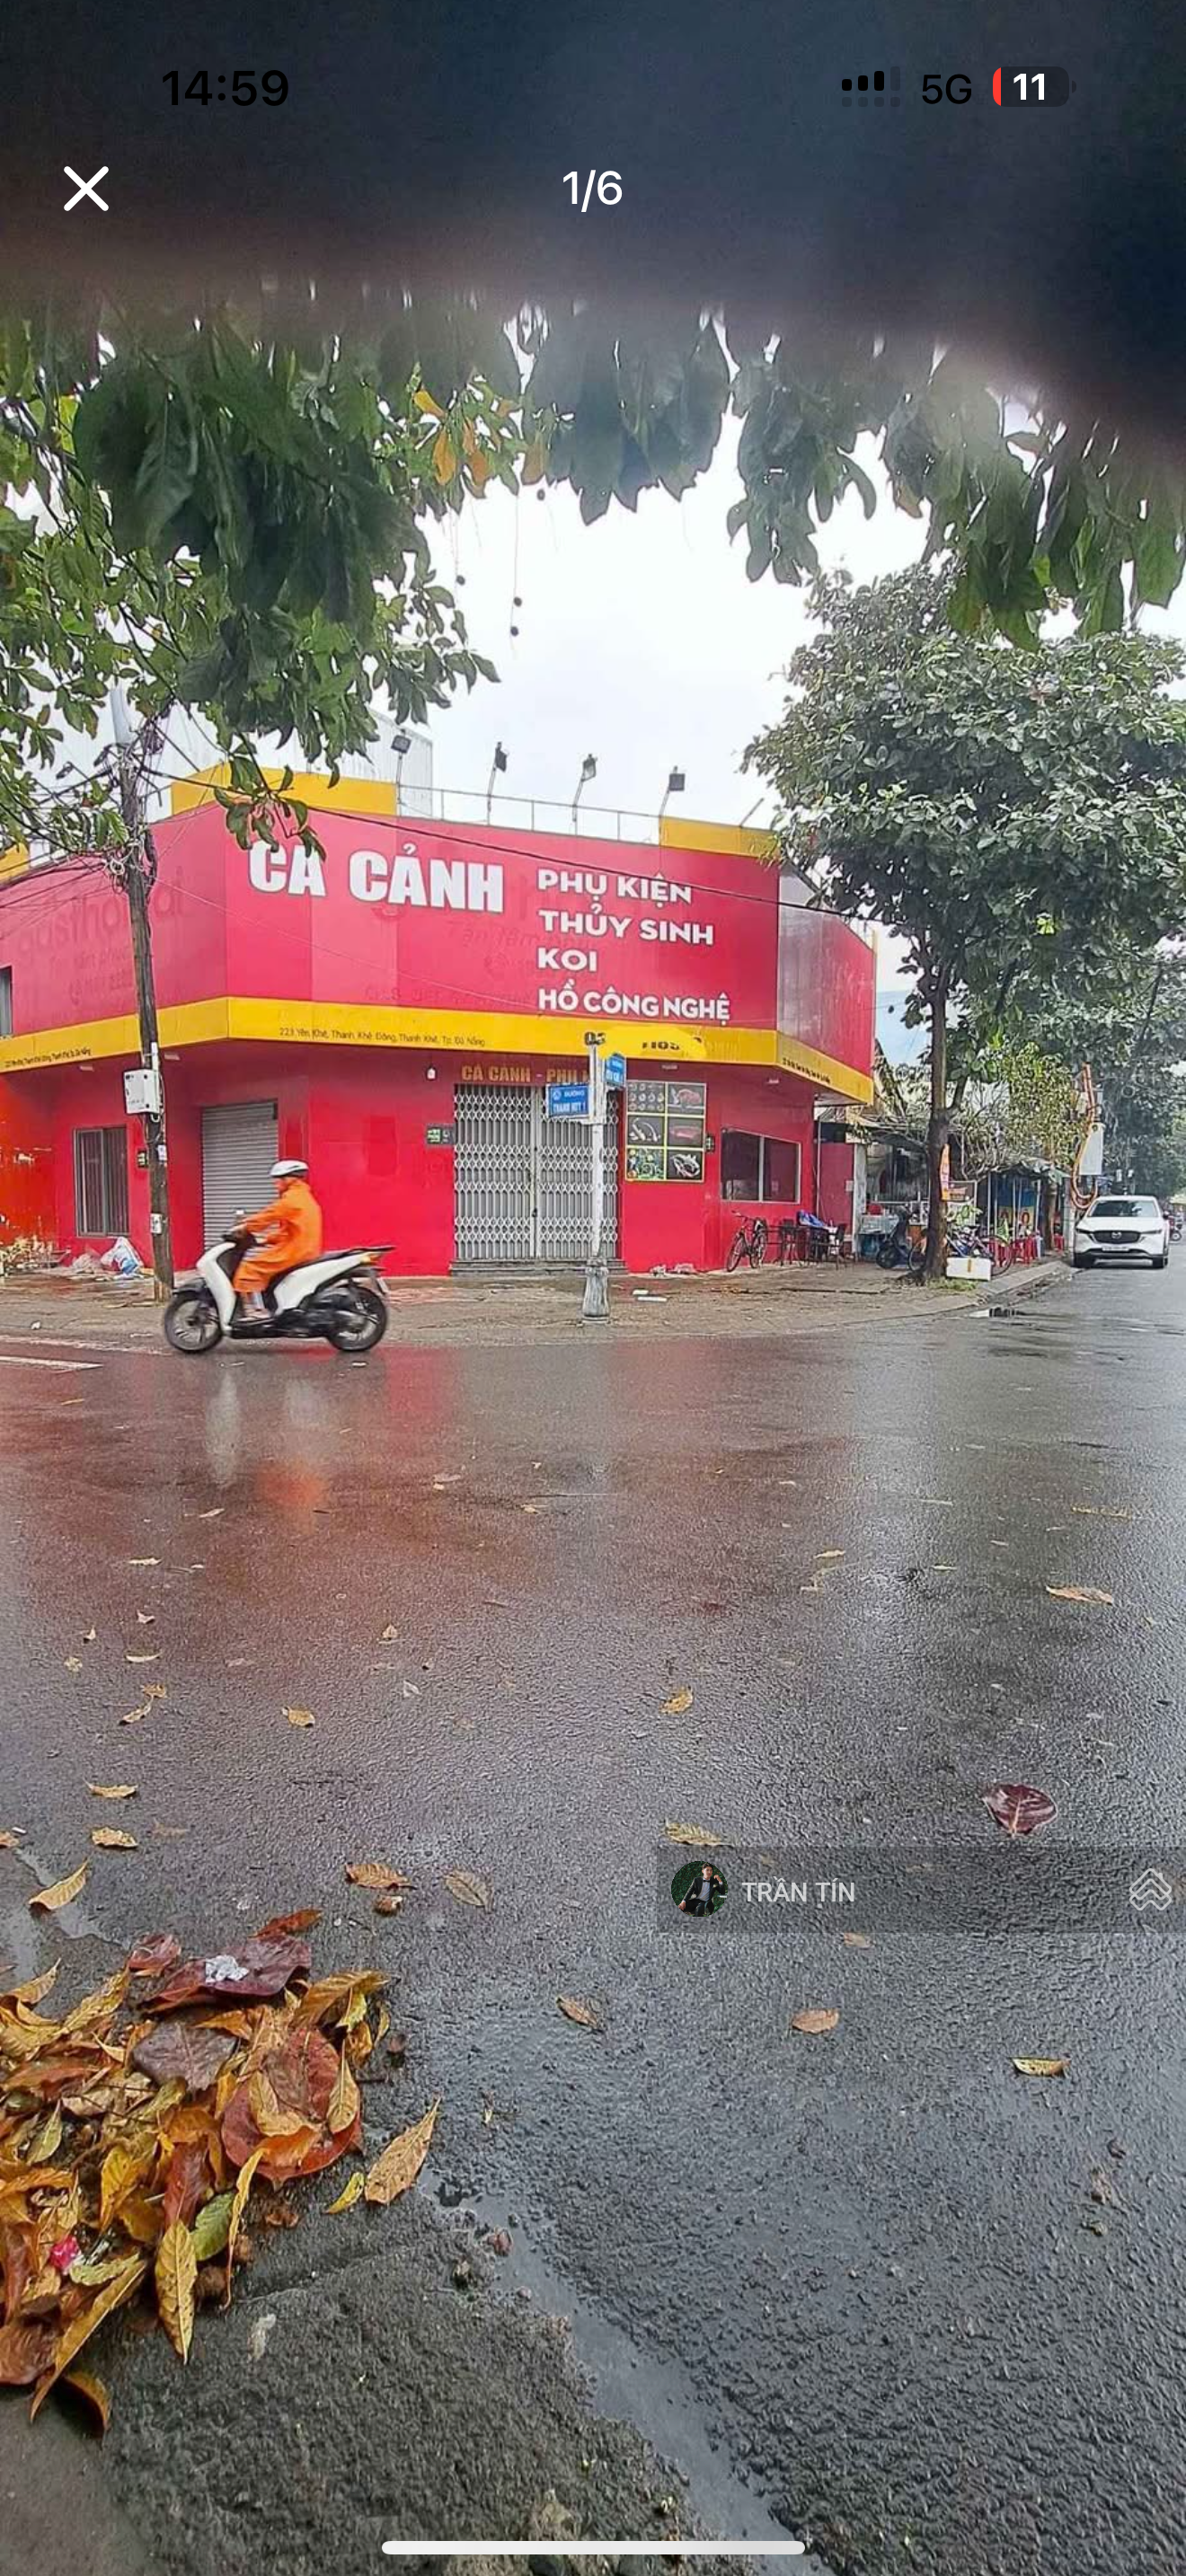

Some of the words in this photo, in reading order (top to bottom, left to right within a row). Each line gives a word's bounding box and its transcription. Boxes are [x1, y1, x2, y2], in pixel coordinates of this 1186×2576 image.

[349, 843, 503, 913] CẢNH
[537, 869, 607, 901] PHỤ
[617, 871, 692, 908] KIỆN
[538, 903, 632, 938] THỦY
[640, 919, 713, 945] SINH
[537, 948, 597, 972] KOI
[539, 978, 579, 1011] HỒ
[583, 986, 659, 1017] CÔNG
[663, 992, 730, 1026] NGHỆ
